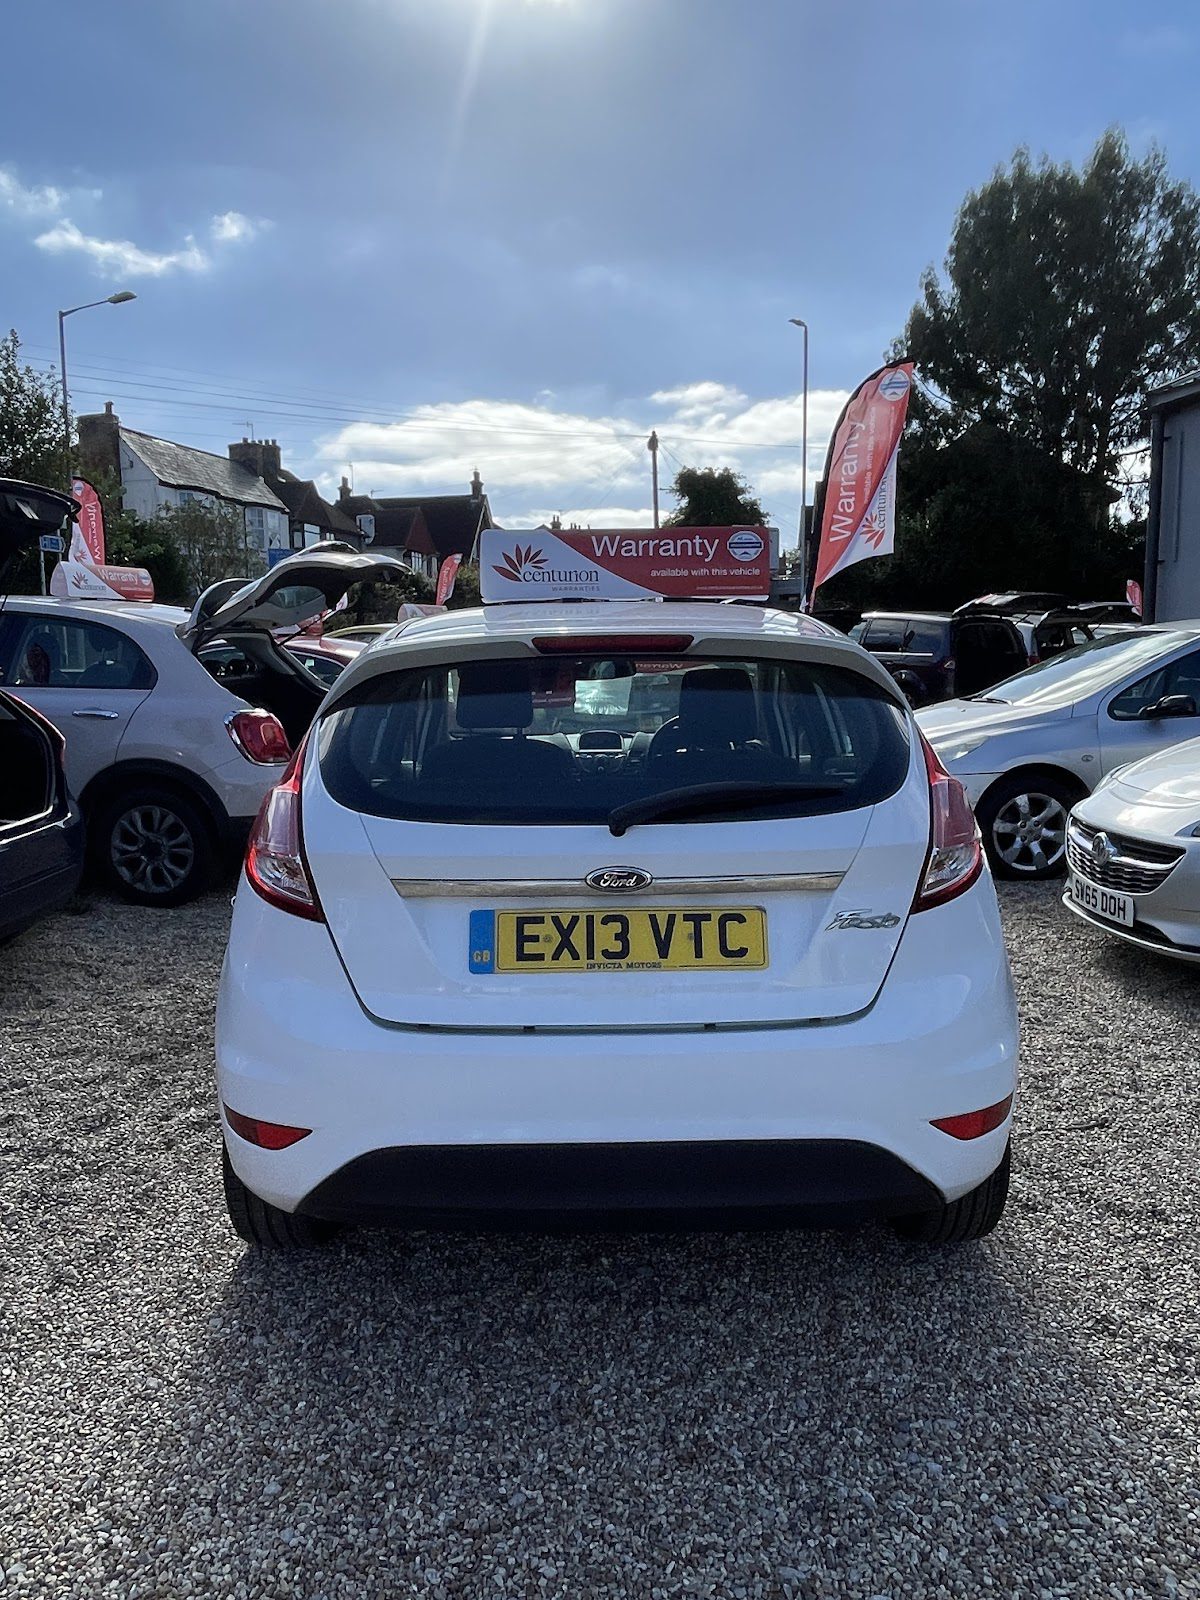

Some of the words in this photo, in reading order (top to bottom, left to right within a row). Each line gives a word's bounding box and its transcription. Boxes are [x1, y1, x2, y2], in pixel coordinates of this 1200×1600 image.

[829, 420, 865, 542] Warranty
[591, 534, 719, 562] Warranty
[98, 568, 138, 584] Warranty
[523, 570, 599, 582] centurion
[650, 569, 689, 577] available
[691, 568, 708, 576] with
[711, 567, 727, 576] this
[729, 567, 760, 576] vehicle
[600, 872, 637, 887] Ford
[1075, 880, 1098, 909] SW65
[1101, 891, 1126, 920] DOH
[515, 914, 630, 961] EX13
[648, 913, 749, 959] VTC
